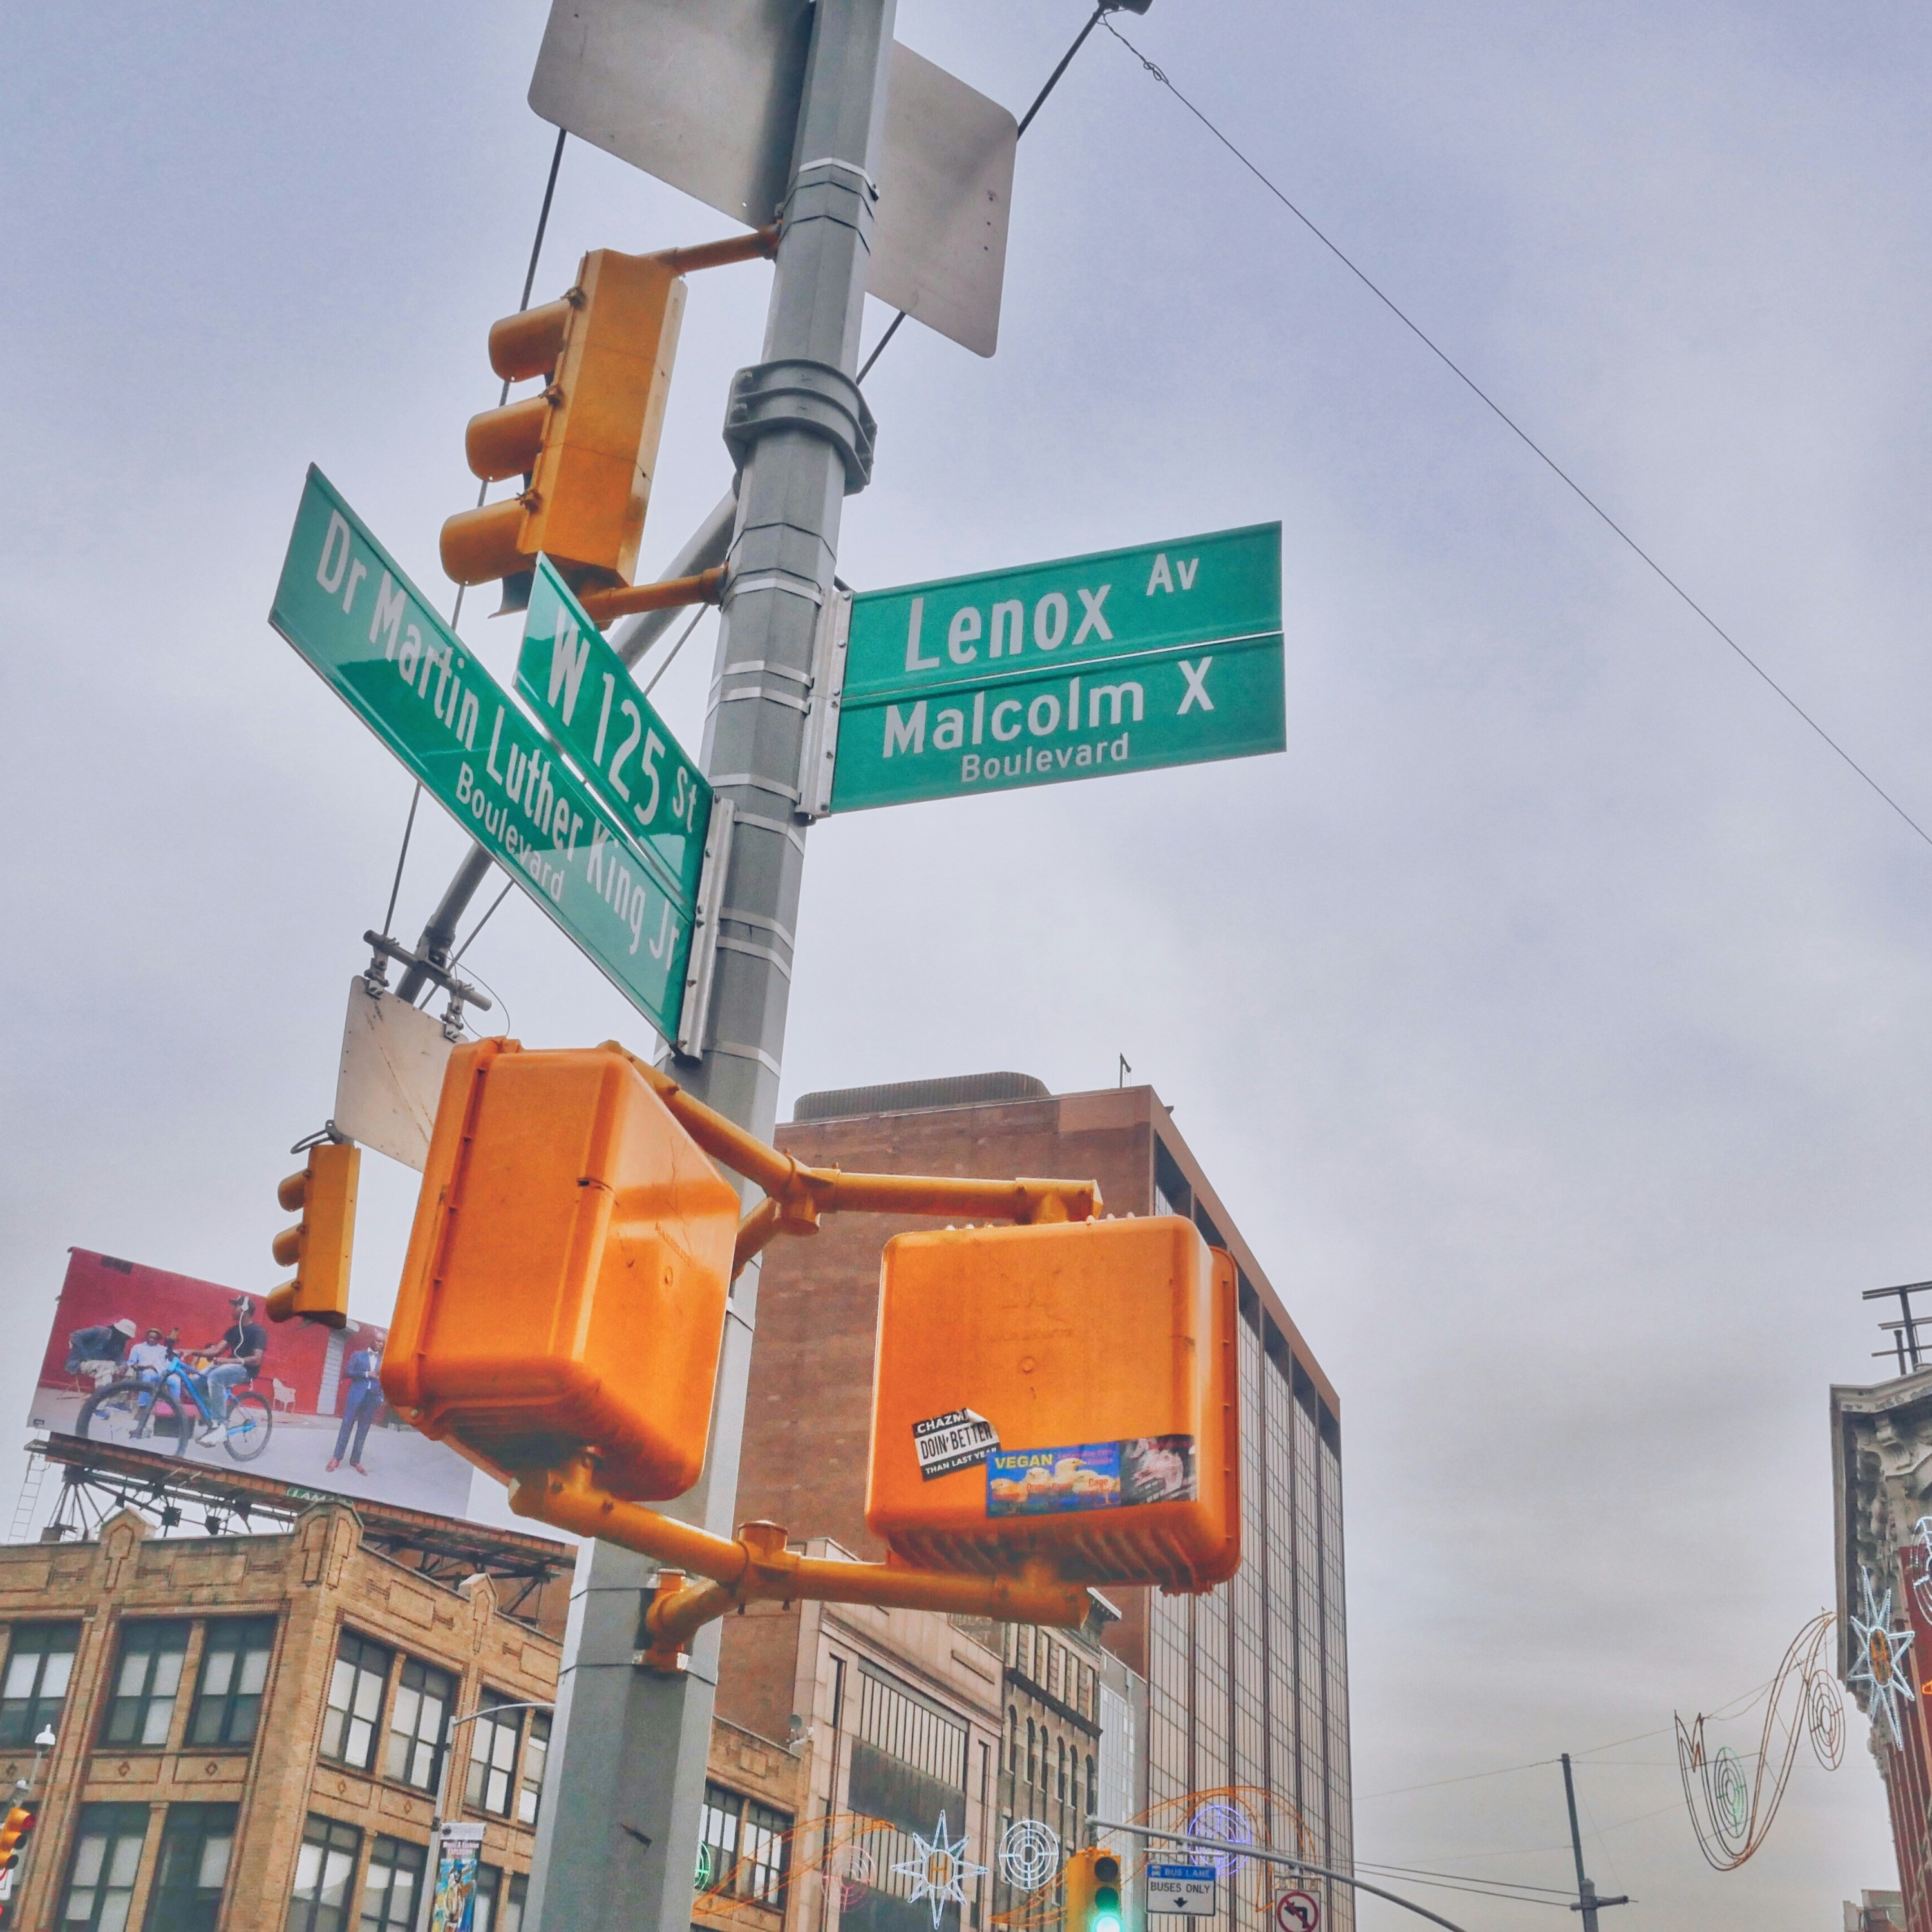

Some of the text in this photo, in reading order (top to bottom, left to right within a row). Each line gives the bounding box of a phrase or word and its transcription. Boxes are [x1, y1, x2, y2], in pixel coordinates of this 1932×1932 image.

[905, 553, 1199, 671] Lenox Av
[549, 605, 697, 833] W 125 St
[882, 656, 1215, 758] Malcolm X
[317, 510, 681, 971] Dr Martin Luther King Jr
[961, 733, 1129, 782] Boulevard
[457, 762, 565, 901] Boulevard
[917, 1409, 969, 1434] CHAZM
[949, 1422, 992, 1450] BETTER
[925, 1461, 949, 1475] THAN
[952, 1454, 972, 1466] LAST
[995, 1454, 1053, 1469] VEGAN
[1151, 1882, 1210, 1893] BUSES ONLY
[1165, 1868, 1211, 1879] BUS LANE
